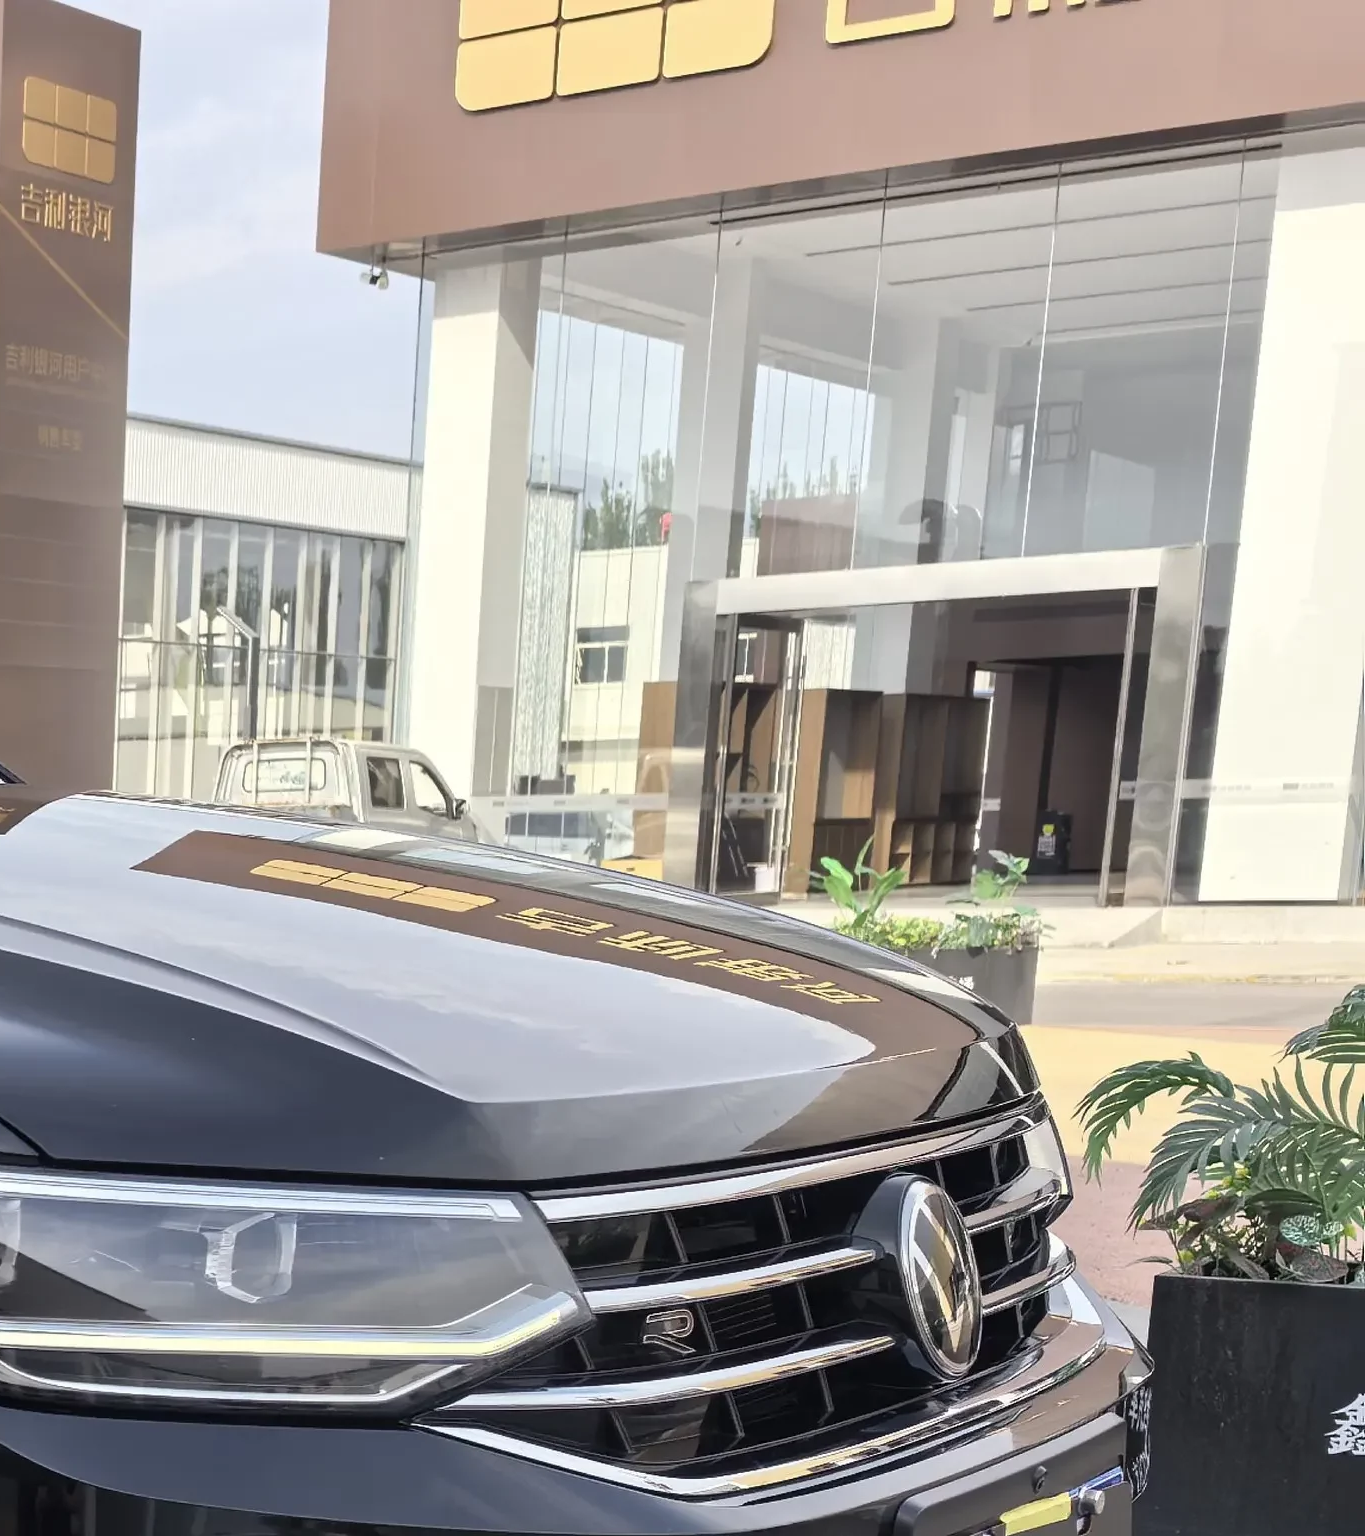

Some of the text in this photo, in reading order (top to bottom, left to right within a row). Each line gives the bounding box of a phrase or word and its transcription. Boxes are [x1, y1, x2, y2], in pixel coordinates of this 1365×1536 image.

[20, 183, 114, 242] 吉利银河
[642, 1308, 696, 1357] R
